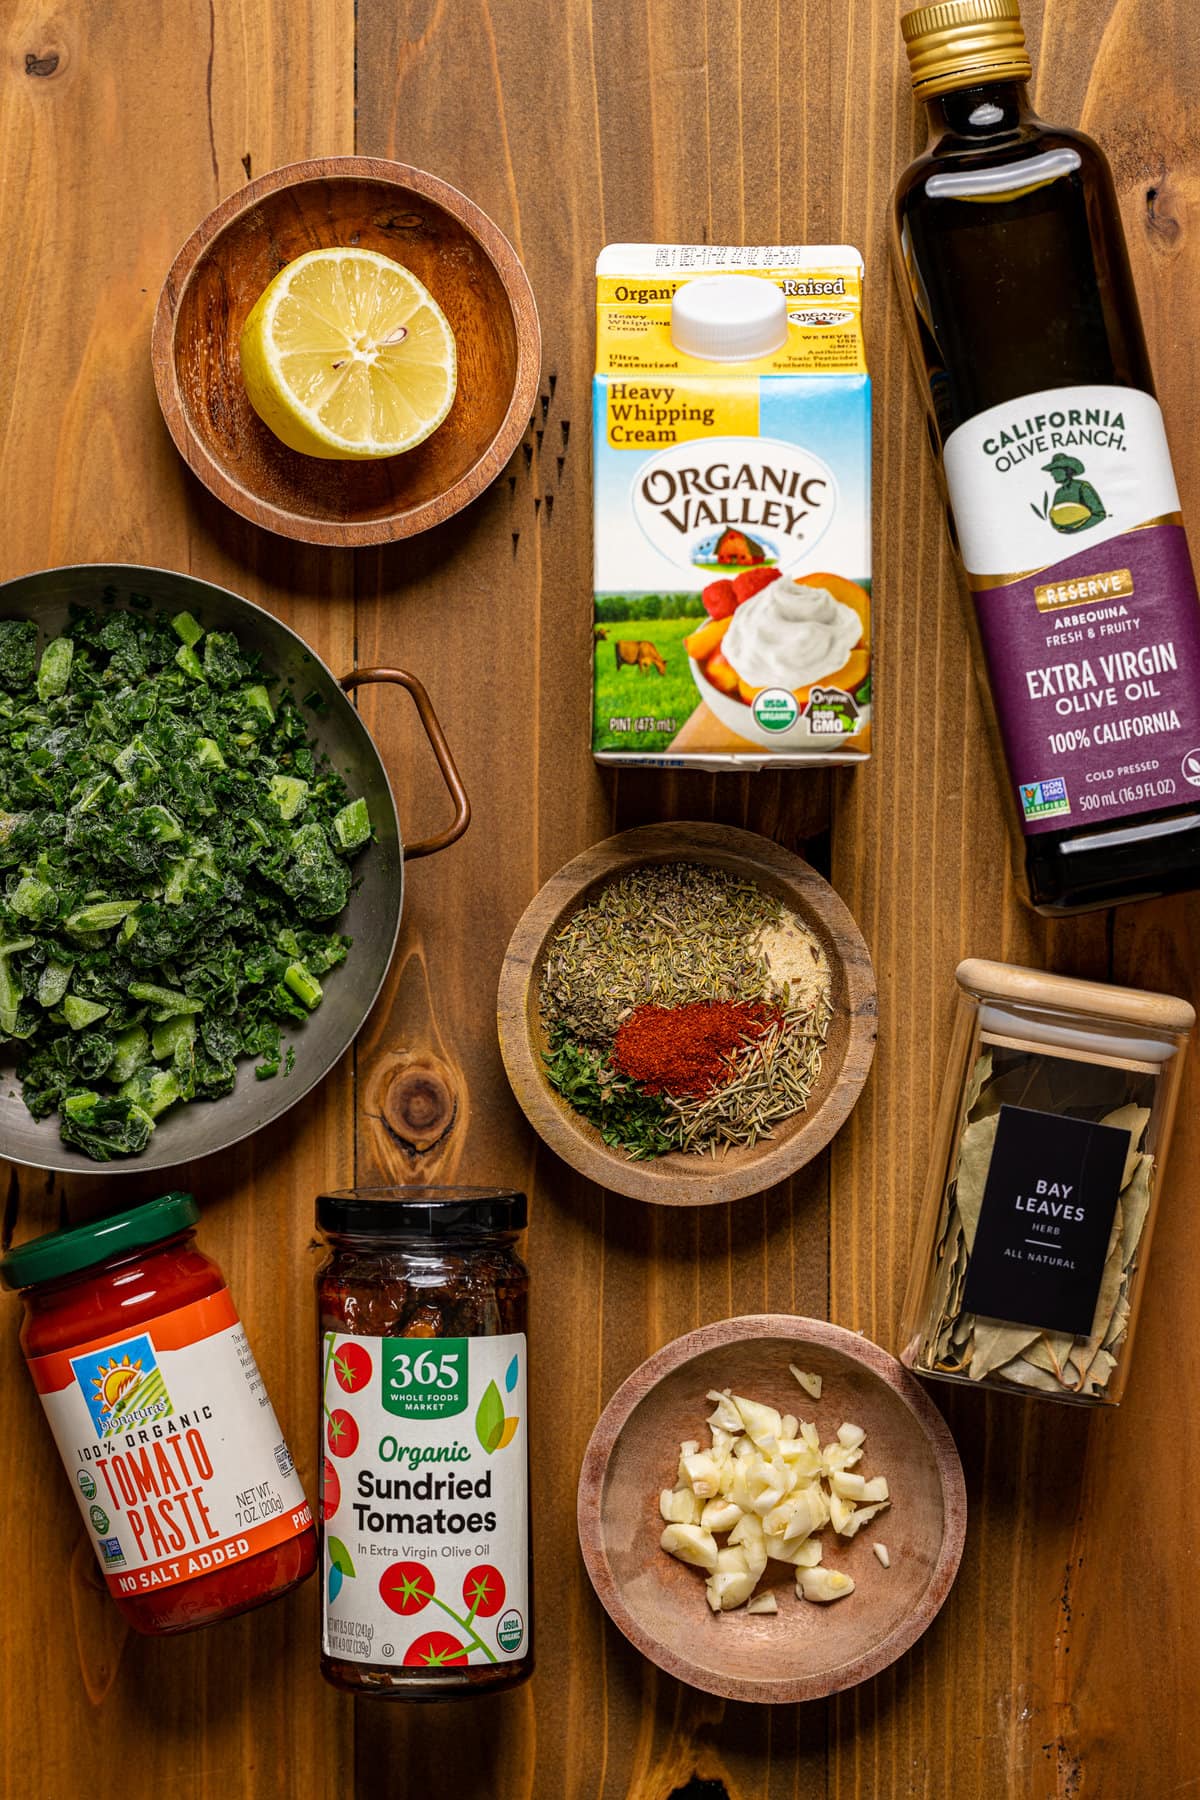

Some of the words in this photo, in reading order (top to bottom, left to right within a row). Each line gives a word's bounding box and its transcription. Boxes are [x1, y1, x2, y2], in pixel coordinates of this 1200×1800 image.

[615, 284, 676, 305] Organi
[783, 278, 846, 297] Raised
[608, 319, 672, 327] Whipping
[609, 353, 639, 361] Ultra
[609, 360, 679, 369] Pasteurized
[610, 383, 675, 404] Heavy
[610, 404, 715, 426] Whipping
[610, 425, 678, 443] Cream
[982, 409, 1126, 456] CALIFORNIA
[995, 435, 1050, 473] OLIVE
[641, 463, 827, 508] ORGANIC
[1045, 575, 1122, 605] RESERVE
[1054, 605, 1129, 630] ARBEQUINA
[1046, 630, 1083, 648] FRESH
[1087, 628, 1096, 639] &
[1100, 617, 1141, 636] FRUITY
[1025, 659, 1099, 700] EXTRA
[1099, 641, 1179, 684] VIRGIN
[1055, 688, 1118, 715] OLIVE
[1124, 680, 1161, 701] OIL
[610, 717, 631, 731] PINT
[634, 717, 655, 733] (473
[656, 718, 676, 733] mL)
[812, 719, 843, 733] GMO
[1047, 728, 1091, 755] 100%
[1093, 709, 1181, 746] CALIFORNIA
[1085, 769, 1114, 783] COLD
[1117, 759, 1160, 776] PRESSED
[1079, 794, 1100, 811] 500
[1102, 791, 1118, 807] mL
[1119, 784, 1143, 806] (16.9
[1144, 782, 1156, 797] FL
[1157, 779, 1176, 795] OZ)
[1035, 1179, 1073, 1199] BAY
[1015, 1195, 1085, 1222] LEAVES
[1032, 1222, 1060, 1235] HERB
[1004, 1248, 1022, 1259] ALL
[1027, 1252, 1076, 1269] NATURAL
[390, 1349, 459, 1389] 365
[390, 1393, 424, 1401] WHOLE
[427, 1393, 459, 1401] FOODS
[405, 1403, 445, 1411] MARKET
[77, 1440, 116, 1463] 100%
[125, 1405, 213, 1448] ORGANIC
[378, 1435, 472, 1471] Organic
[96, 1428, 214, 1511] TOMATO
[235, 1488, 257, 1508] NET
[256, 1481, 274, 1499] WT.
[357, 1469, 492, 1500] Sundried
[127, 1486, 220, 1561] PASTE
[234, 1512, 243, 1528] 7
[243, 1506, 261, 1524] OZ.
[259, 1493, 285, 1519] (200g)
[352, 1502, 497, 1535] Tomatoes
[119, 1575, 138, 1593] NO
[139, 1562, 182, 1588] SALT
[187, 1537, 250, 1574] ADDED
[358, 1543, 367, 1555] In
[370, 1544, 399, 1557] Extra
[401, 1545, 438, 1560] Virgin
[441, 1545, 472, 1558] Olive
[474, 1543, 490, 1556] Oil
[504, 1619, 519, 1630] USDA
